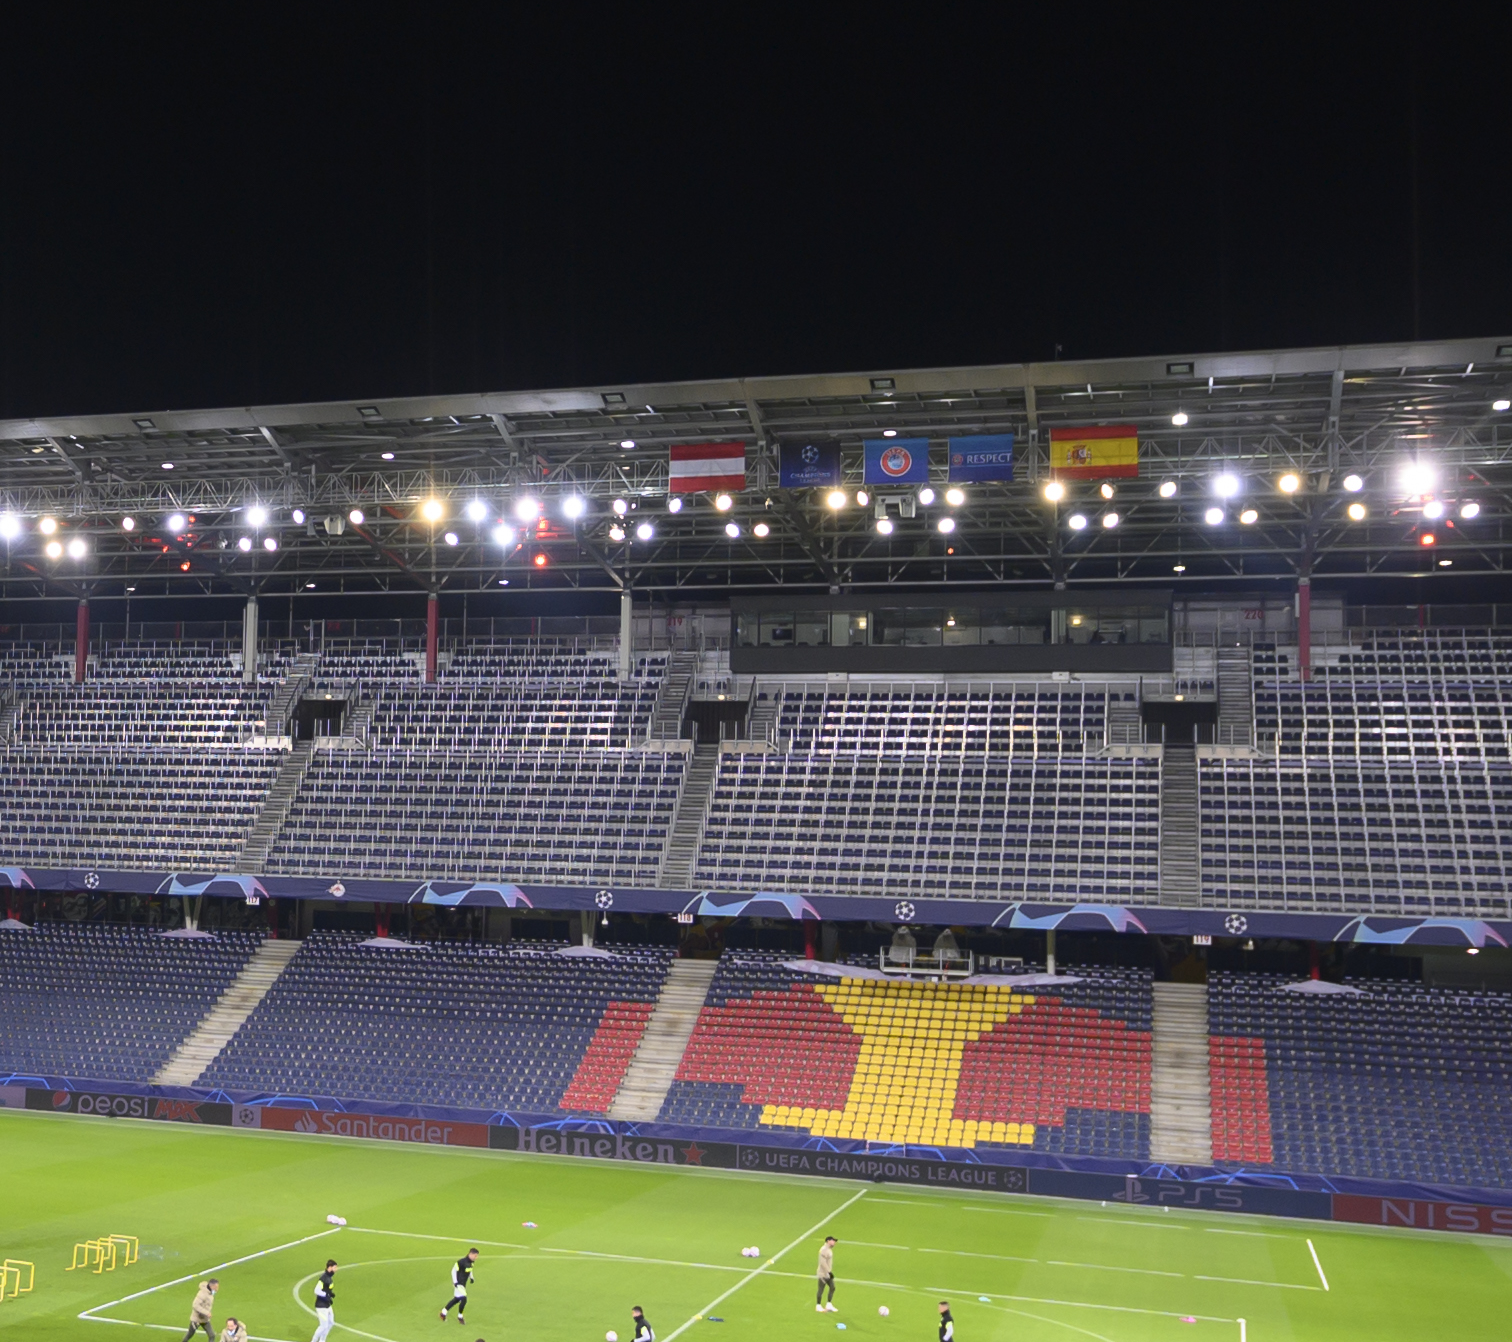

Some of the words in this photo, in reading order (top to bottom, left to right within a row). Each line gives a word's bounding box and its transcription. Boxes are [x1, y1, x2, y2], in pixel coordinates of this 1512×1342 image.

[967, 452, 1012, 464] RESPECT
[1244, 609, 1264, 620] 220
[153, 1099, 203, 1122] MAX
[321, 1112, 453, 1146] Santander
[516, 1126, 677, 1164] Heineken
[765, 1153, 811, 1170] UEFA
[816, 1157, 921, 1180] CHAMPIONS
[927, 1166, 997, 1186] LEAGUE
[1158, 1183, 1243, 1208] PS5
